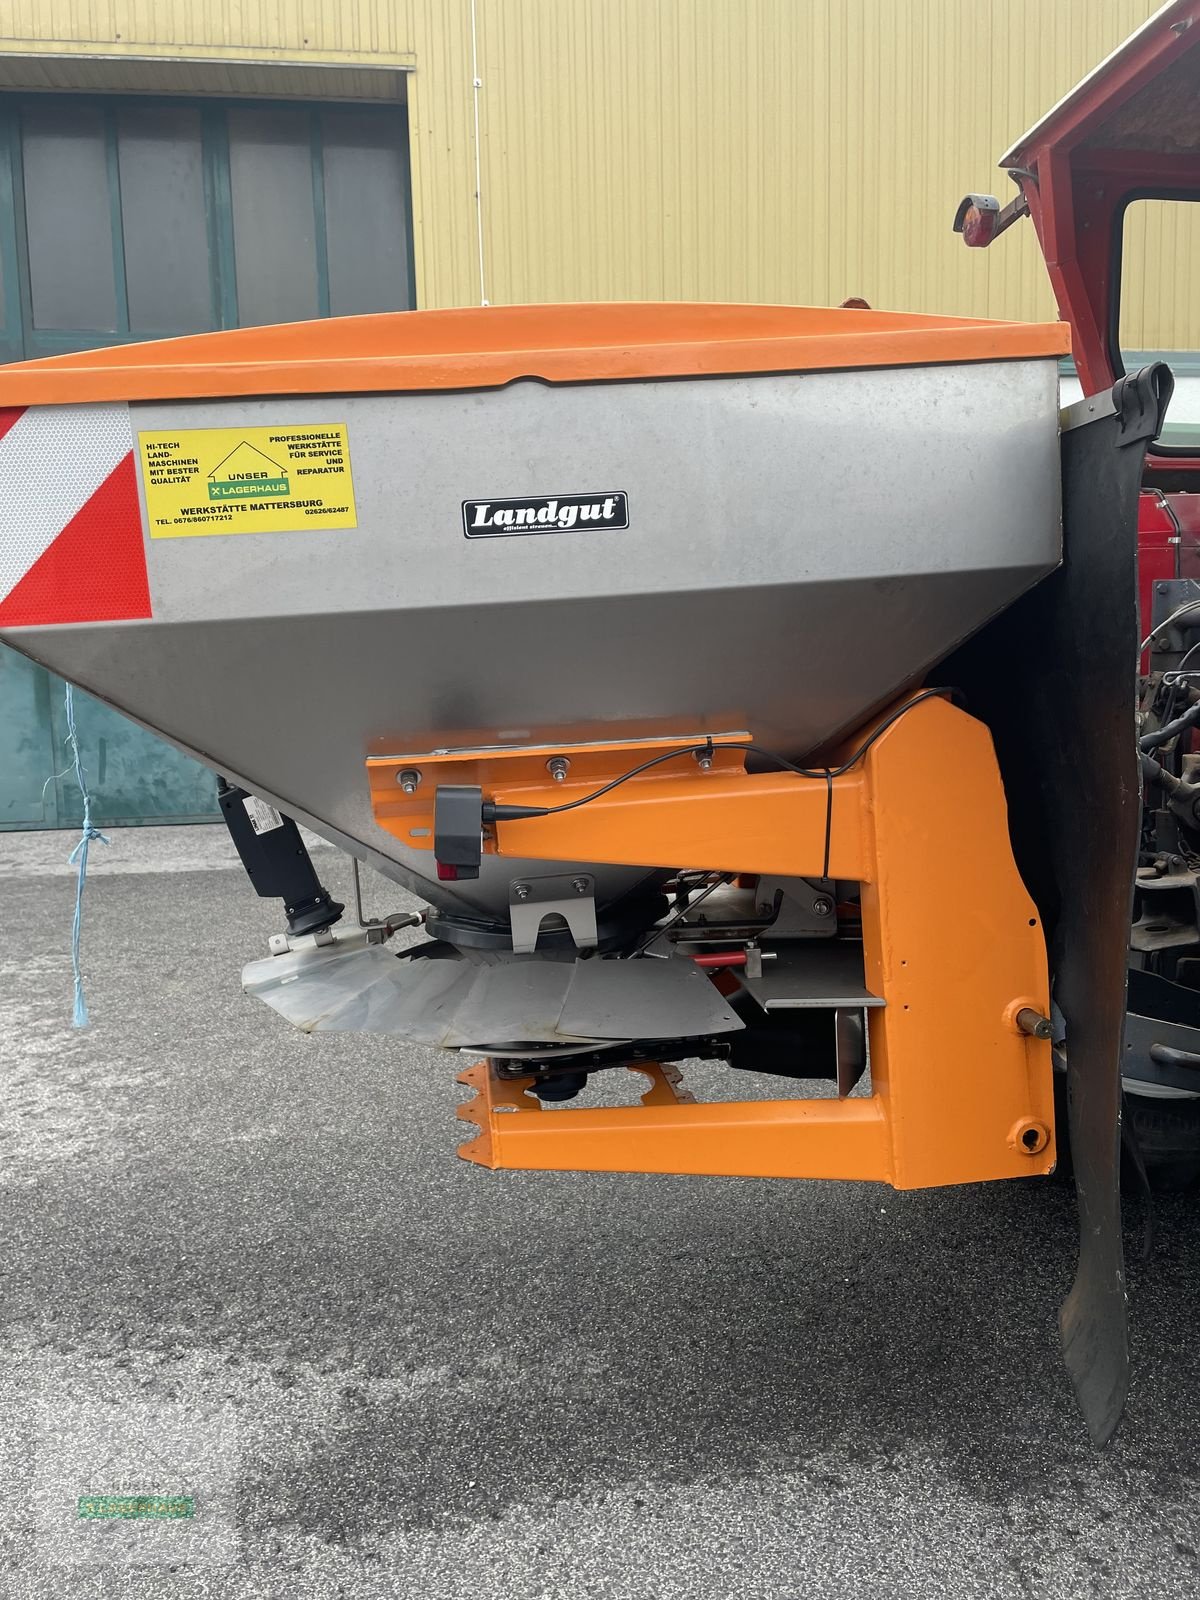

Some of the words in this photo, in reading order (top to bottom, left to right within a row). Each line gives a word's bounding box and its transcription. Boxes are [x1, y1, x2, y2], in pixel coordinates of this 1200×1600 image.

[269, 432, 341, 443] PROFESSIONELLE
[146, 442, 180, 450] HI-TECH
[287, 441, 342, 450] WERKSTÄTTE
[147, 451, 172, 459] LAND-
[289, 451, 306, 459] FÜR
[308, 449, 342, 457] SERVICE
[148, 458, 198, 467] MASCHINEN
[167, 467, 200, 475] BESTER
[296, 466, 344, 475] REPARATUR
[150, 476, 191, 485] QUALITÄT
[228, 472, 268, 481] UNSER
[222, 484, 287, 495] LAGERHAUS
[180, 504, 247, 515] WERKSTÄTTE
[250, 499, 323, 511] MATTERSBURG
